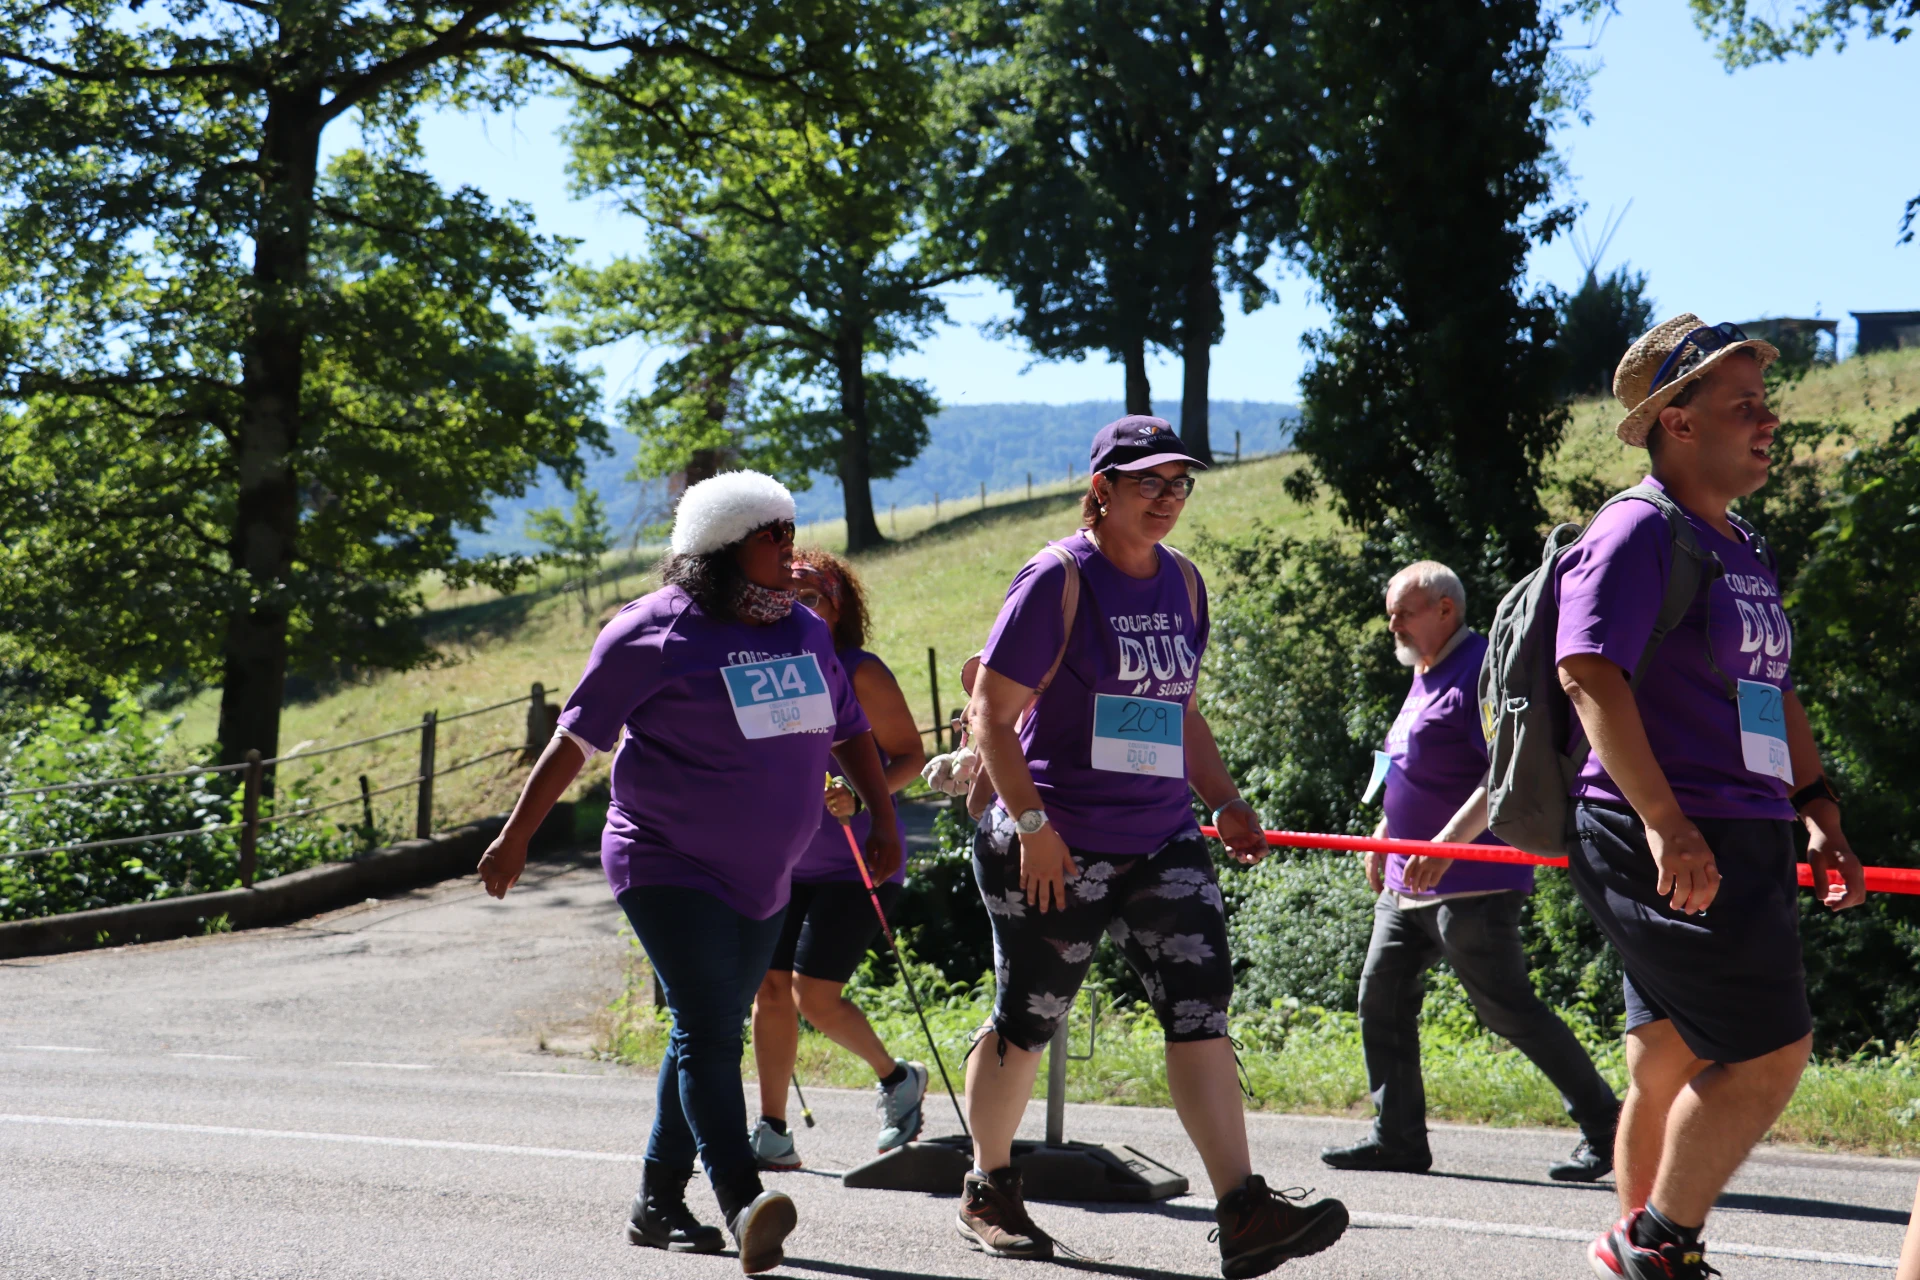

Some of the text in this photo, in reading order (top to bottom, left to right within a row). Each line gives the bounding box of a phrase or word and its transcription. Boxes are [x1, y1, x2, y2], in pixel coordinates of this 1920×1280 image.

[1109, 612, 1170, 633] COURSE
[1117, 634, 1197, 681] DUO
[744, 663, 807, 702] 214
[1156, 680, 1194, 697] SUISSE
[770, 706, 801, 724] DUO
[1118, 701, 1168, 736] 209
[1126, 749, 1157, 765] DUO
